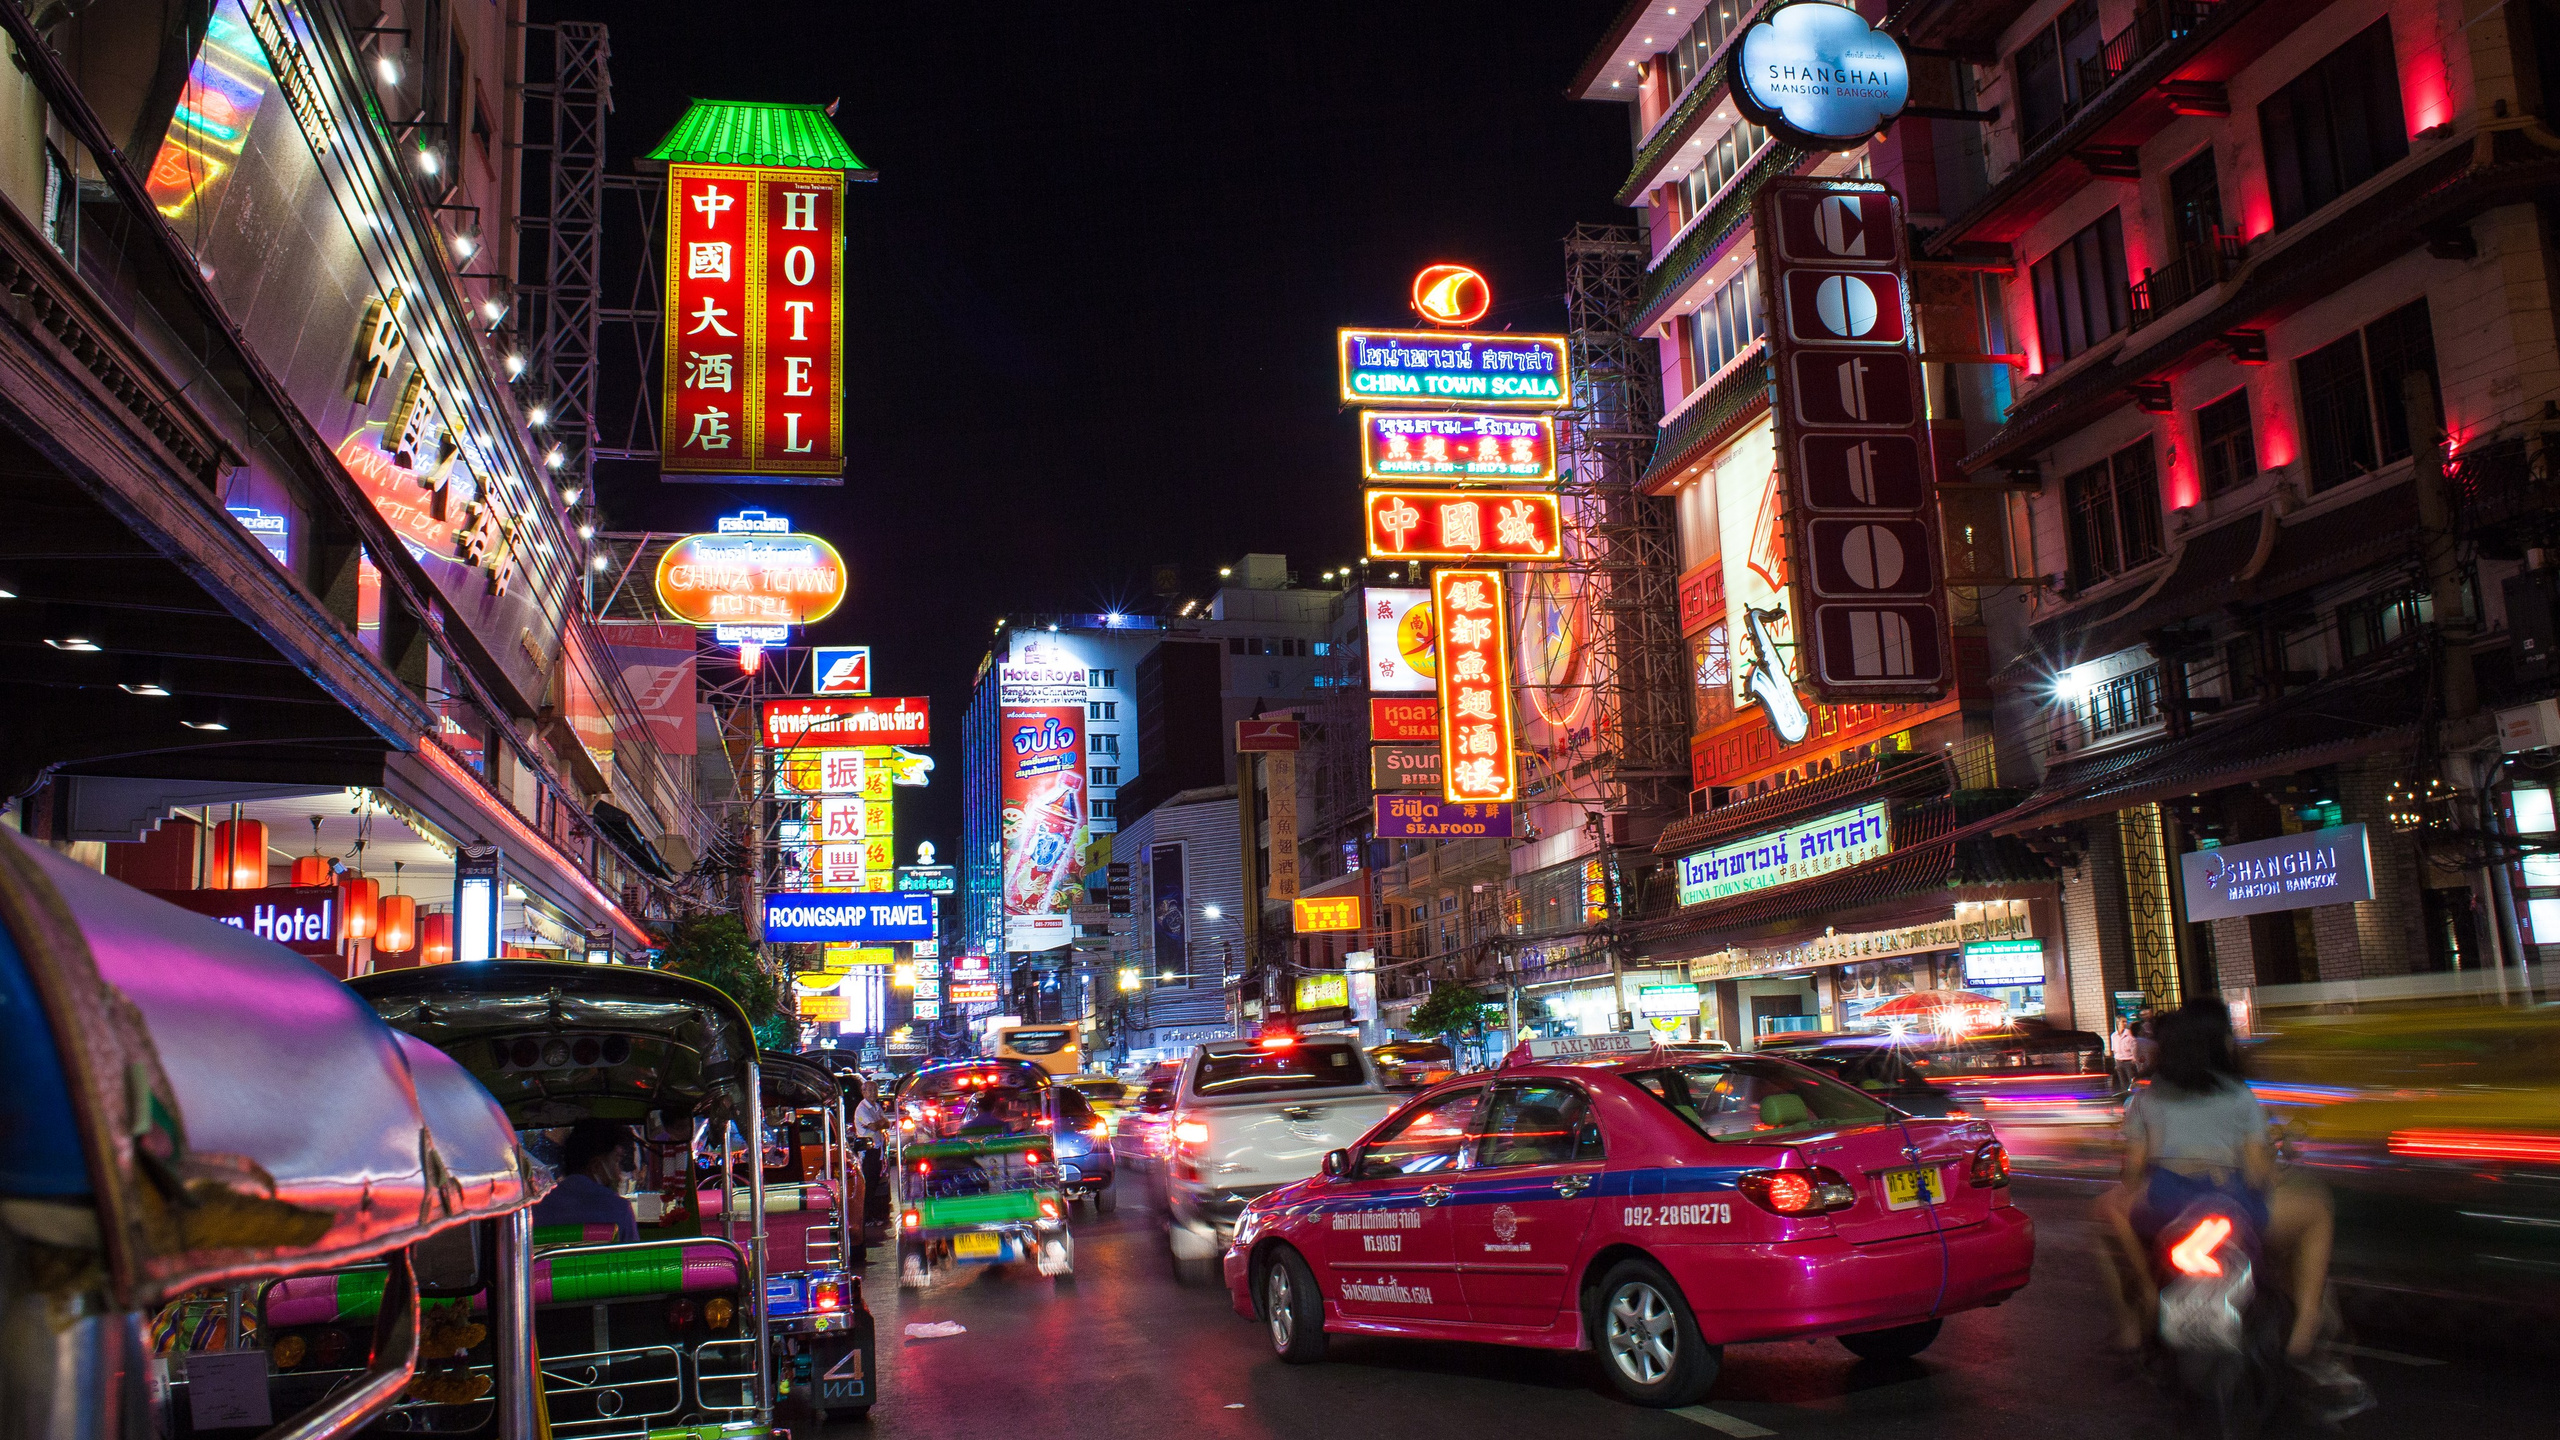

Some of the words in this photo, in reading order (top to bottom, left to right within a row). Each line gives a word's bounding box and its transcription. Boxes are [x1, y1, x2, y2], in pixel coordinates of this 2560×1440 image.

[1769, 65, 1888, 86] SHANGHAI
[1770, 84, 1830, 95] MANSION
[1836, 87, 1890, 99] BANGKOK
[682, 184, 738, 452] 中國大酒店
[782, 192, 819, 453] HOTEL
[1354, 335, 1472, 369] ไชน่าทาวน์
[1482, 344, 1554, 371] สกาล่า
[1355, 373, 1420, 393] CHINA
[1425, 374, 1487, 394] TOWN
[1491, 377, 1560, 396] SCALA
[1509, 462, 1541, 474] NEST
[1379, 496, 1545, 554] 中國城
[668, 564, 755, 592] CHINA
[761, 566, 837, 593] TOWN
[711, 594, 793, 617] HOTEL
[1376, 600, 1396, 679] 燕窩
[1003, 668, 1042, 682] Hotel
[1045, 668, 1085, 684] Royal
[1445, 580, 1506, 794] 銀都魚翅酒樓
[1001, 685, 1037, 699] Bangkok
[1013, 718, 1075, 755] จับใจ
[1060, 751, 1077, 765] 10
[1401, 773, 1441, 785] BIRD
[827, 757, 860, 883] 振成豐
[1463, 803, 1501, 819] 海鮮
[1406, 823, 1486, 834] SEAFOOD
[1681, 832, 1789, 887] ไชน่าทาวน์
[1800, 808, 1883, 860] สกาล่า
[2226, 846, 2337, 884] SHANGHAI
[1683, 888, 1711, 905] CHINA
[1713, 881, 1741, 898] TOWN
[1743, 873, 1776, 891] SCALA
[2228, 880, 2281, 901] MANSION
[2286, 872, 2339, 894] BANGKOK
[254, 899, 332, 942] Hotel
[769, 906, 866, 927] ROONGSARP
[870, 905, 928, 925] TRAVEL
[1900, 928, 1929, 949] TOWN
[1929, 924, 1960, 945] SCALA
[1551, 1036, 1632, 1054] TAXI-METER
[1332, 1208, 1362, 1230] สหกรณ์
[1398, 1208, 1421, 1229] จำกัด
[1624, 1204, 1732, 1227] 092-2860279
[823, 1348, 864, 1381] 4
[823, 1380, 864, 1399] WD
